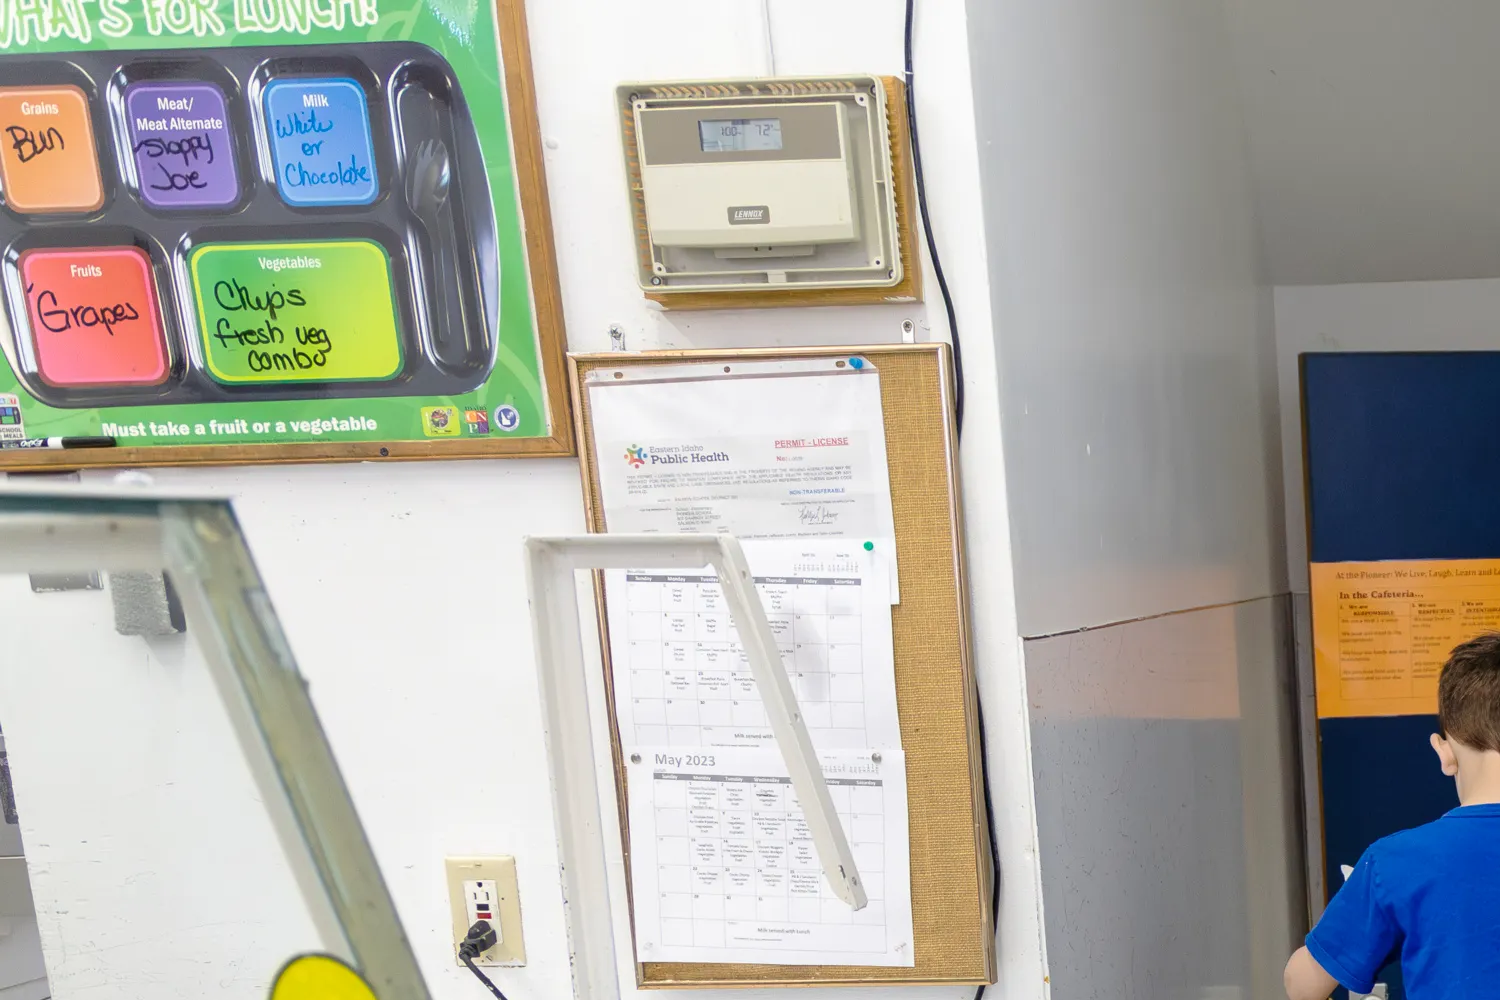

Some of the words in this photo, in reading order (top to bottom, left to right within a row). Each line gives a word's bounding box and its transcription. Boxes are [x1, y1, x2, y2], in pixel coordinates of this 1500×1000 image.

[157, 97, 194, 112] Meat/
[303, 94, 329, 107] Milk
[21, 101, 59, 116] Grains
[137, 118, 169, 131] Meat
[170, 116, 223, 131] Alternate
[276, 109, 333, 138] White
[6, 126, 64, 163] Bun
[133, 133, 213, 166] Sloppy
[302, 140, 323, 156] or
[152, 163, 207, 190] Joe
[285, 154, 371, 187] Chocolate
[735, 210, 763, 218] LENNOX
[71, 264, 102, 278] Fruits
[258, 256, 322, 272] Vegetables
[37, 290, 139, 335] Grapes
[214, 318, 284, 348] fresh
[296, 327, 332, 353] veg
[248, 348, 327, 372] combo
[101, 422, 147, 437] Must
[150, 421, 190, 436] take
[194, 424, 206, 435] a
[209, 420, 249, 435] fruit
[252, 421, 272, 434] or
[275, 421, 287, 433] a
[290, 416, 377, 434] vegetable
[649, 446, 680, 454] Eastern
[774, 438, 806, 449] PERMIT
[812, 437, 849, 447] LICENSE
[651, 454, 688, 465] Public
[691, 452, 730, 463] Health
[1395, 570, 1408, 578] We
[1339, 591, 1349, 599] In
[1352, 591, 1368, 599] the
[655, 753, 682, 768] May
[686, 755, 716, 767] 2023
